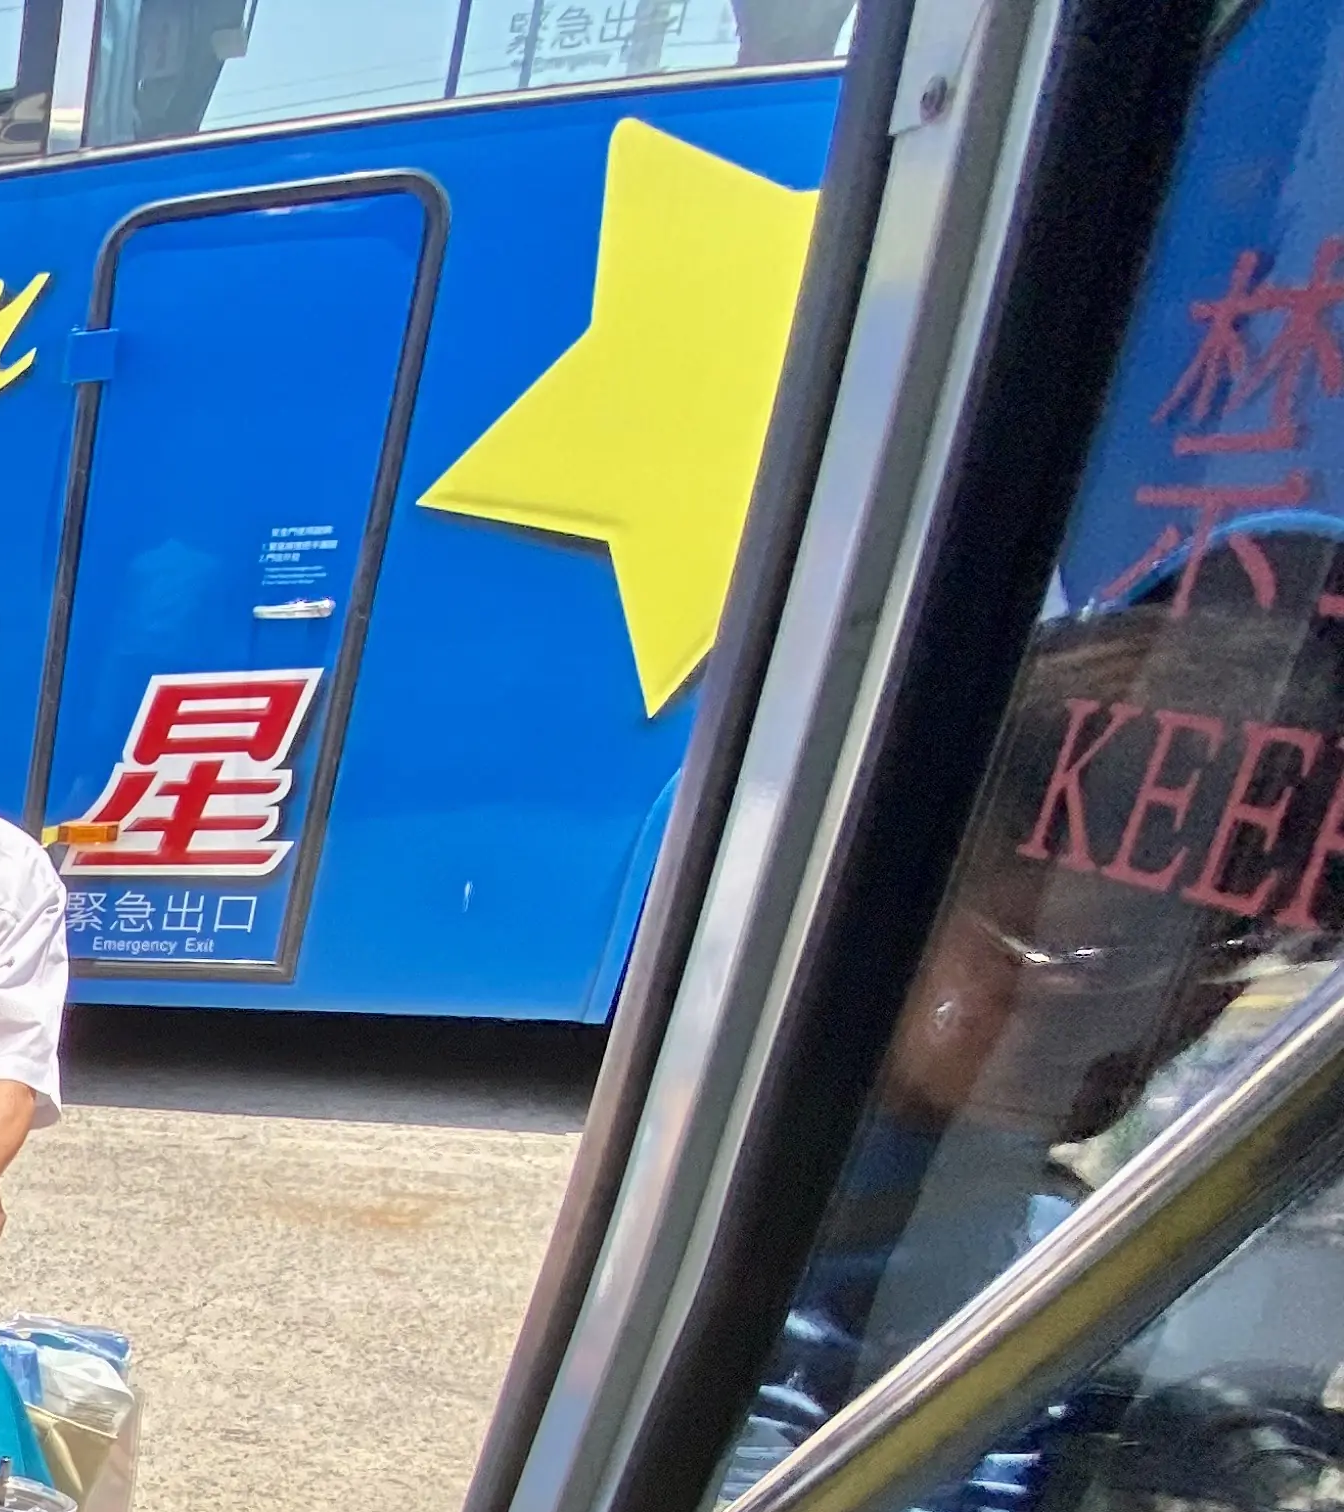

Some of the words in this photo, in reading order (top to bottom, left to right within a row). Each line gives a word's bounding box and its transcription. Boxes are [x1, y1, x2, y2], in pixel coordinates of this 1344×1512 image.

[60, 667, 325, 876] 星
[65, 890, 258, 933] 緊急出口
[92, 936, 177, 955] Emergency
[184, 937, 214, 953] Exit
